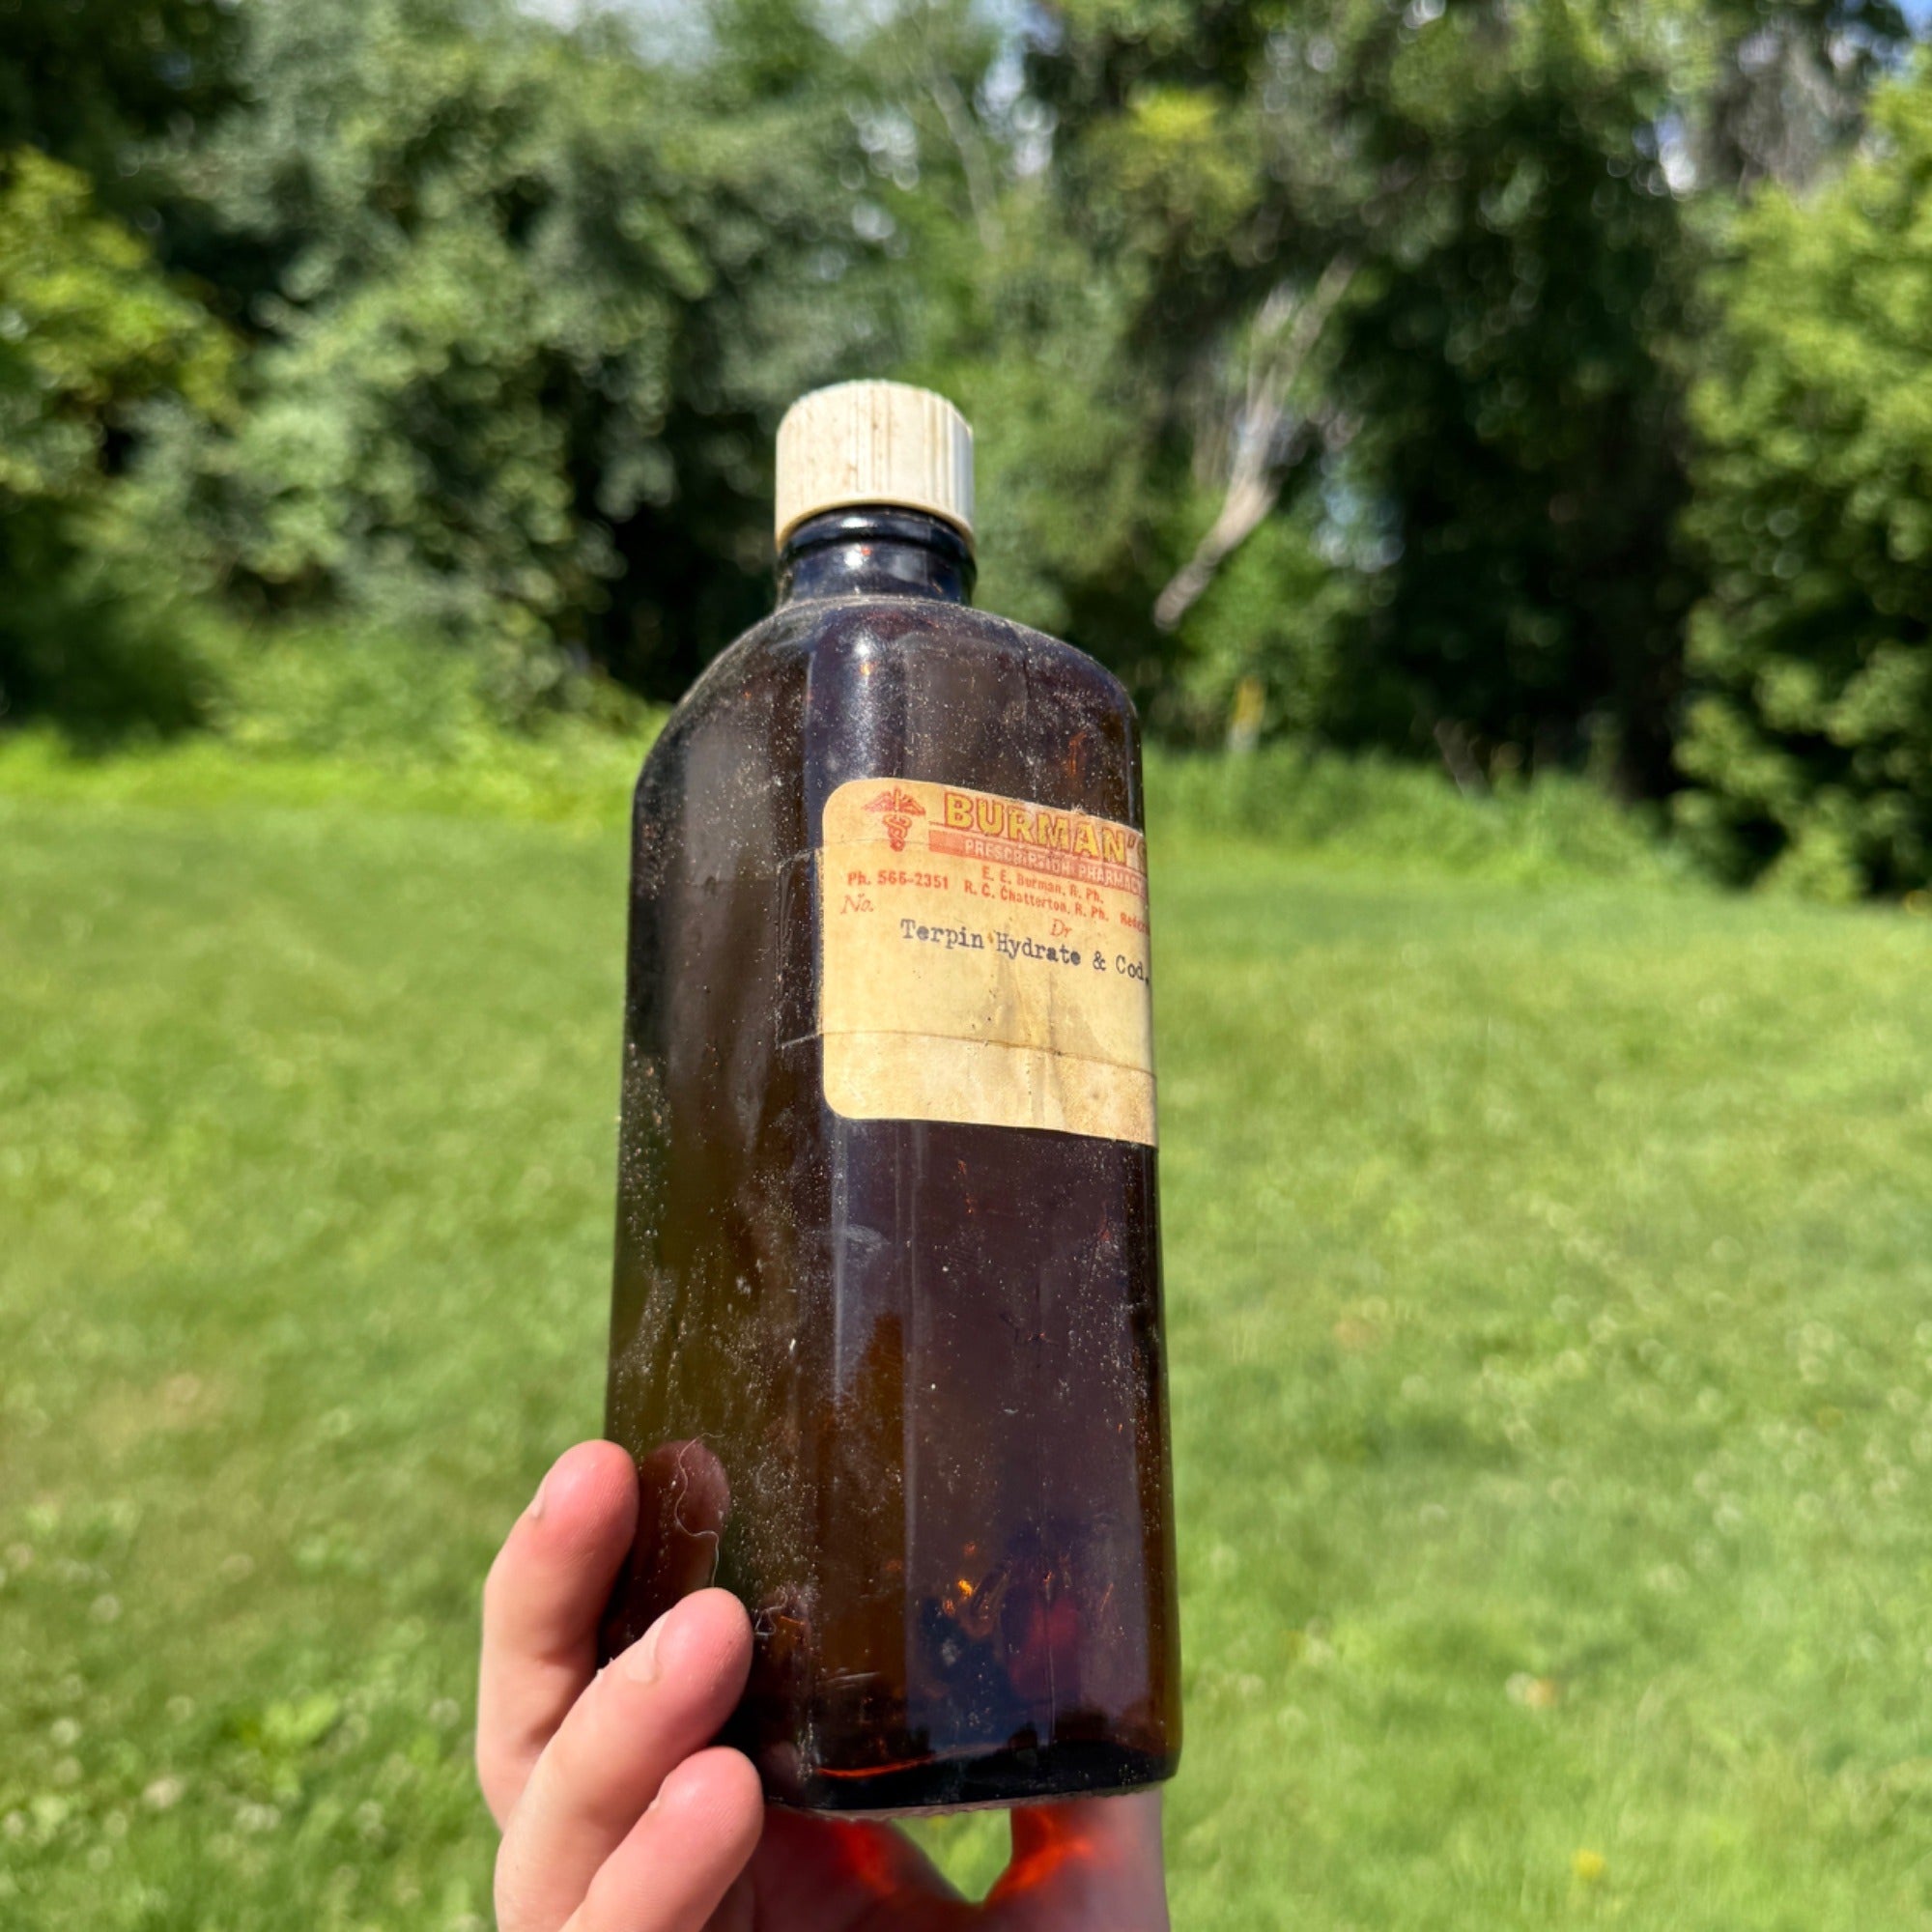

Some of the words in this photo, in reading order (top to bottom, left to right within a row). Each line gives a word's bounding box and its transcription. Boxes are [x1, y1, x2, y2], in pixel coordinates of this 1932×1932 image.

[847, 870, 871, 887] Ph.
[981, 865, 995, 882] E.
[1000, 868, 1012, 885] E.
[1086, 887, 1104, 904] Ph.
[964, 879, 978, 895] R.
[981, 882, 996, 899] C.
[1075, 901, 1087, 918] R.
[1091, 905, 1109, 923] Ph.
[900, 919, 984, 950] Terpin
[996, 931, 1081, 966] Hydrate
[1093, 951, 1106, 971] &
